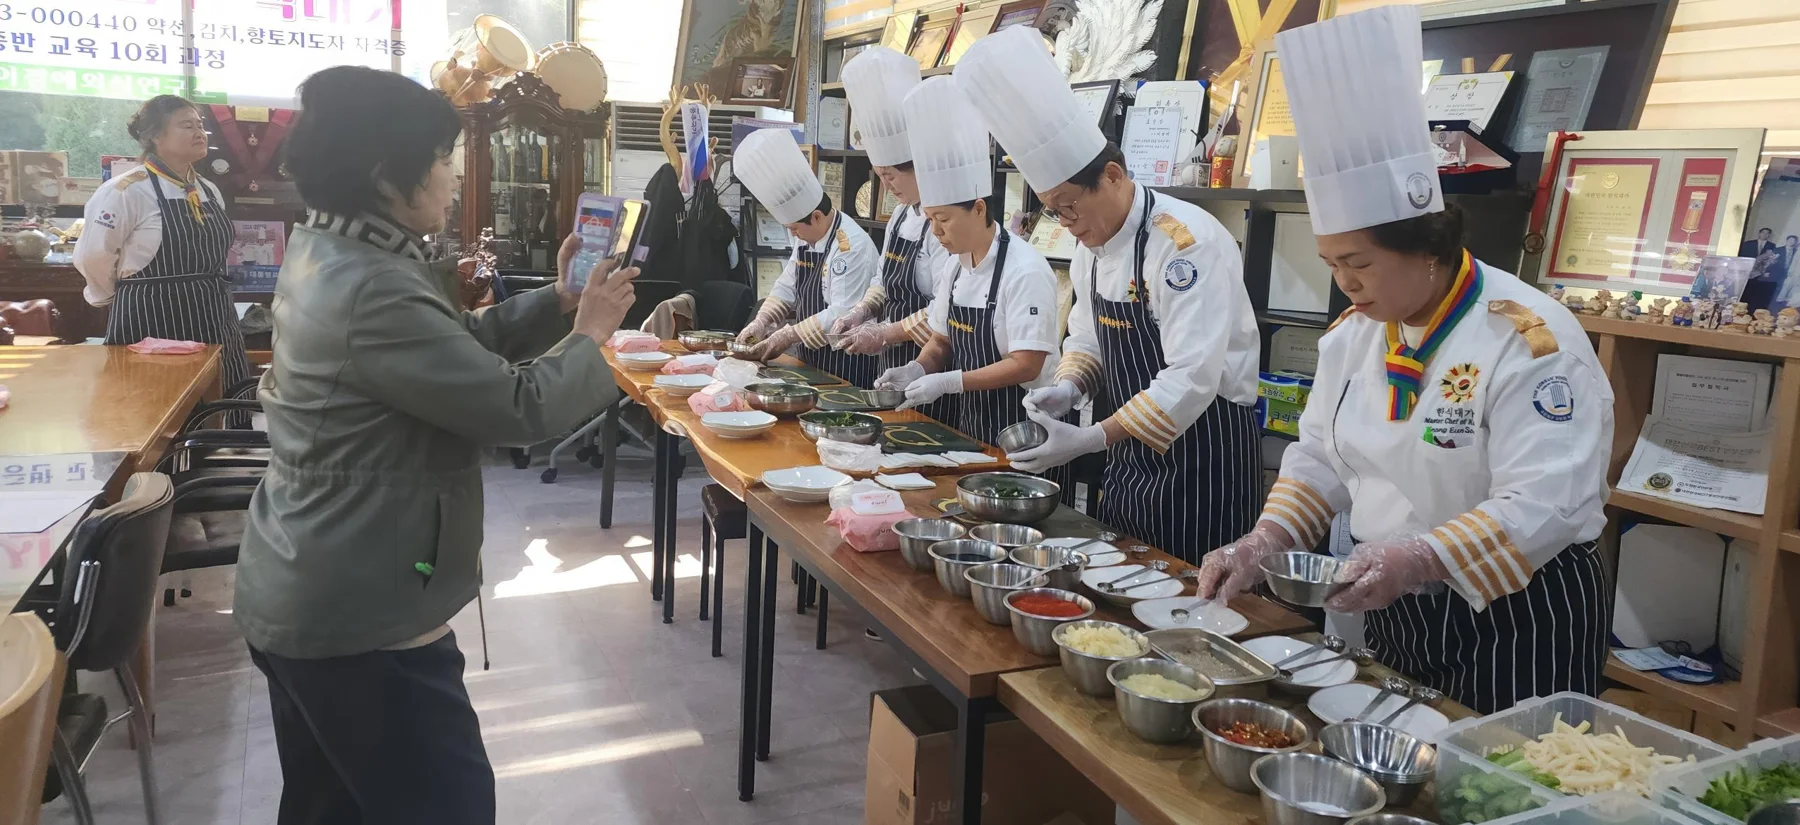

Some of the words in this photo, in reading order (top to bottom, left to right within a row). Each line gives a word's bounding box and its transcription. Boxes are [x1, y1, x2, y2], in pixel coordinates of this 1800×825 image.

[48, 35, 98, 59] 교육
[110, 41, 167, 64] 10회
[178, 46, 226, 69] 과정
[355, 37, 407, 57] 자격증
[1436, 407, 1475, 418] 한식대가
[1444, 417, 1459, 425] Chef
